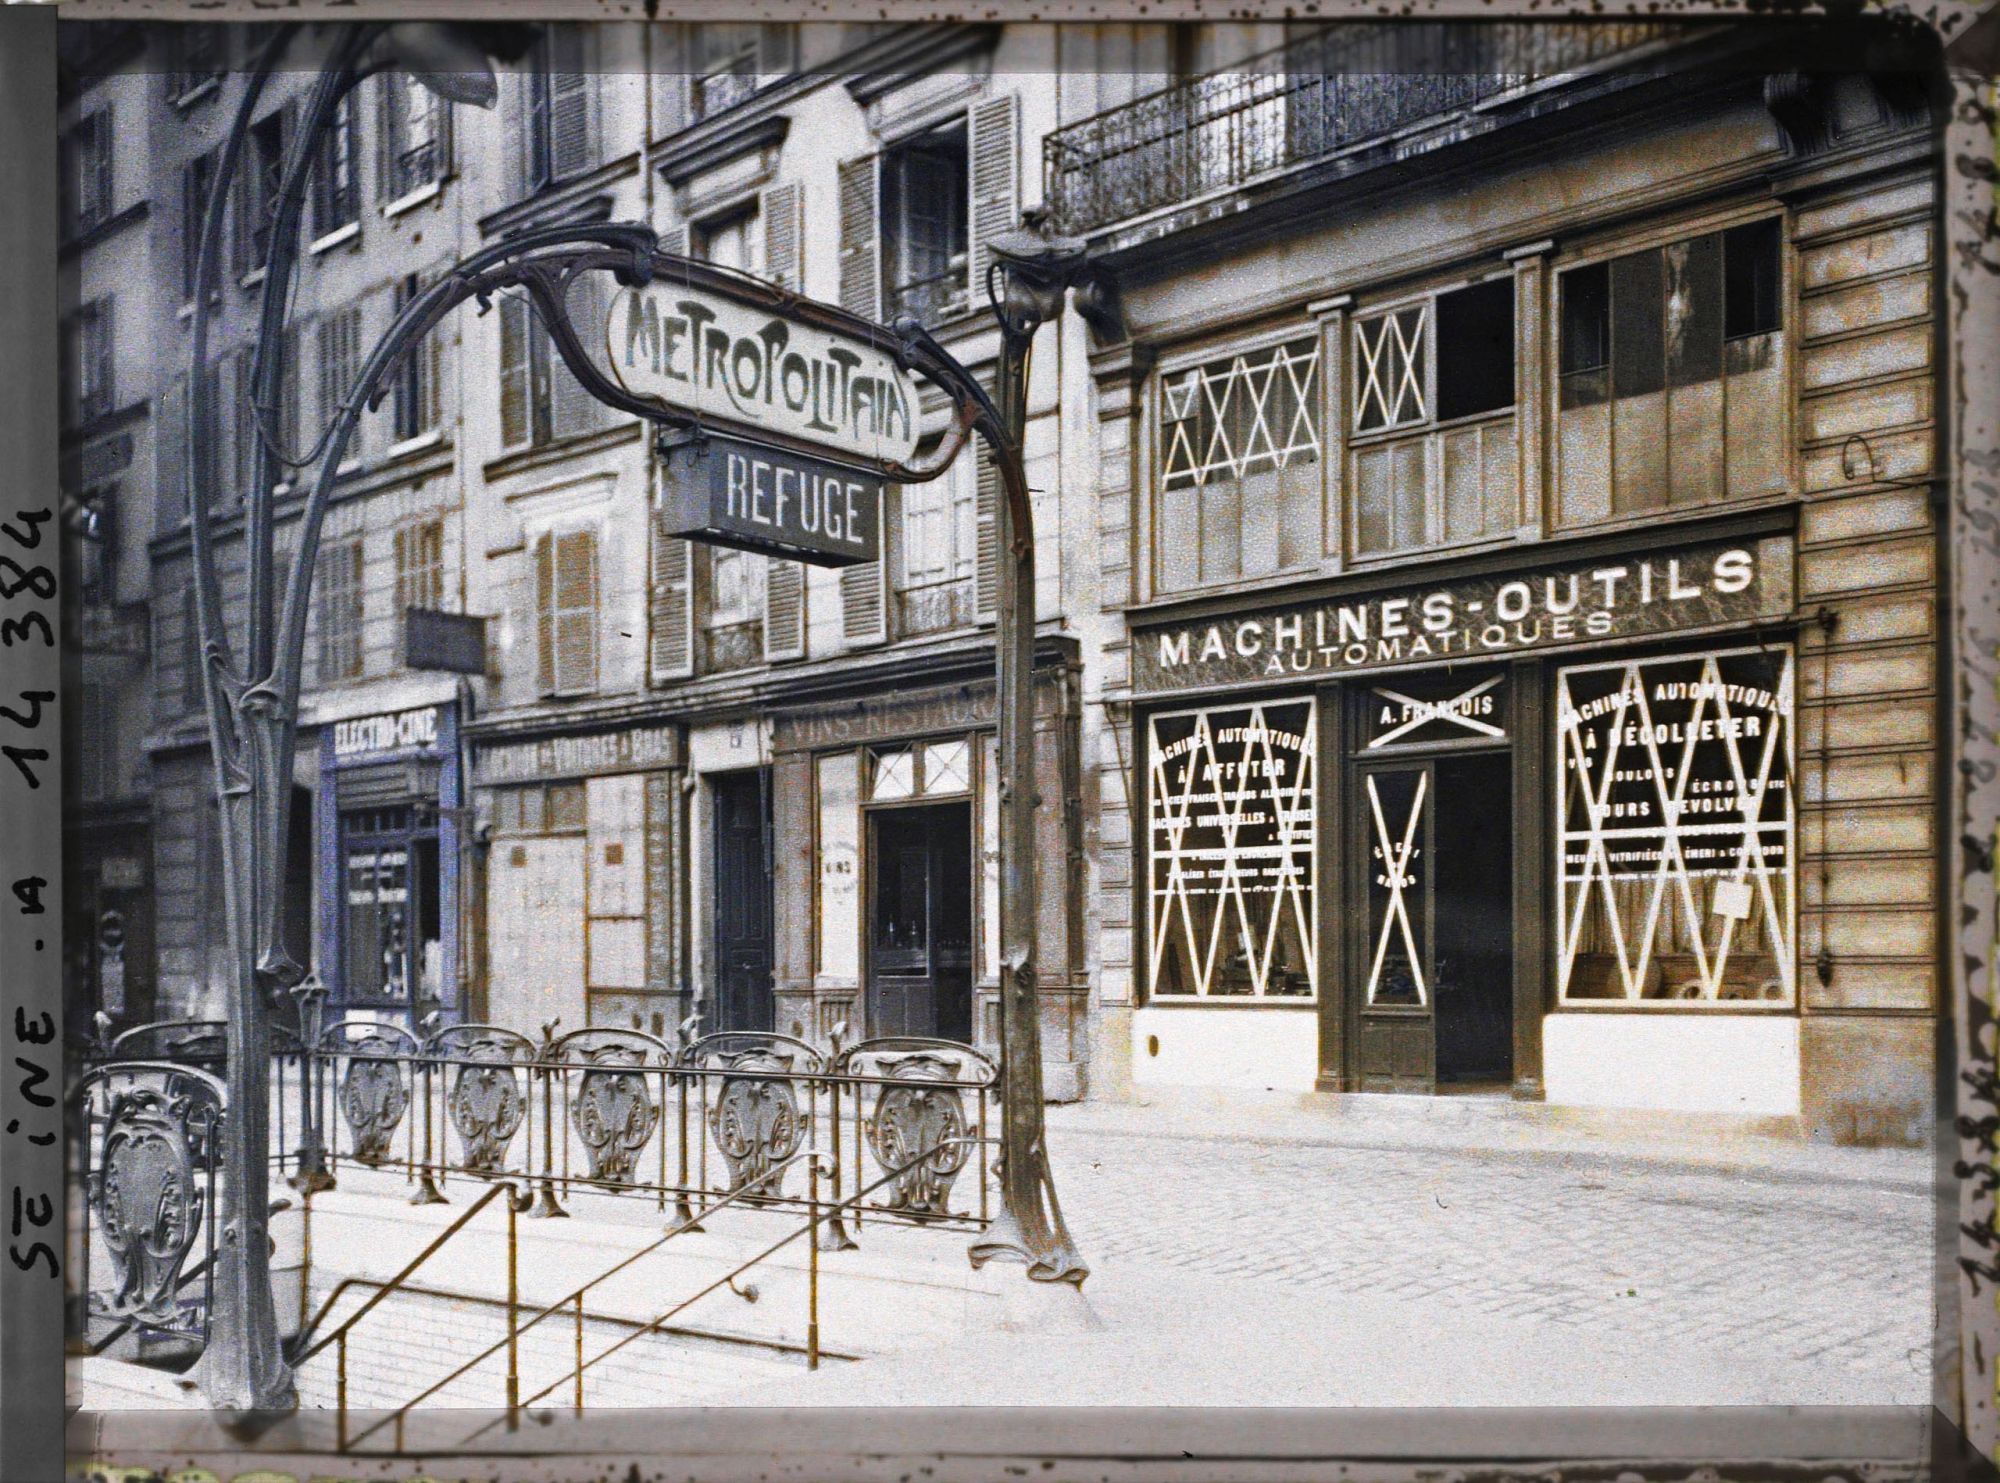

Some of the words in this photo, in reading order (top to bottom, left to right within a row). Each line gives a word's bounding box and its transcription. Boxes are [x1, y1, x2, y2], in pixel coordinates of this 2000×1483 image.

[625, 291, 911, 443] METROPOLITAIN
[726, 453, 865, 545] REFUGE
[1160, 549, 1753, 668] MACHINES-OUTILS
[1264, 611, 1613, 676] AUTOMATIQUES
[1379, 705, 1398, 724] A.
[1149, 733, 1208, 767] ACHINES
[1567, 756, 1594, 770] VS
[1604, 766, 1675, 782] OULOS
[1691, 778, 1759, 794] ÉCROS
[1668, 793, 1757, 816] EVOLVE
[1728, 845, 1785, 858] CODON
